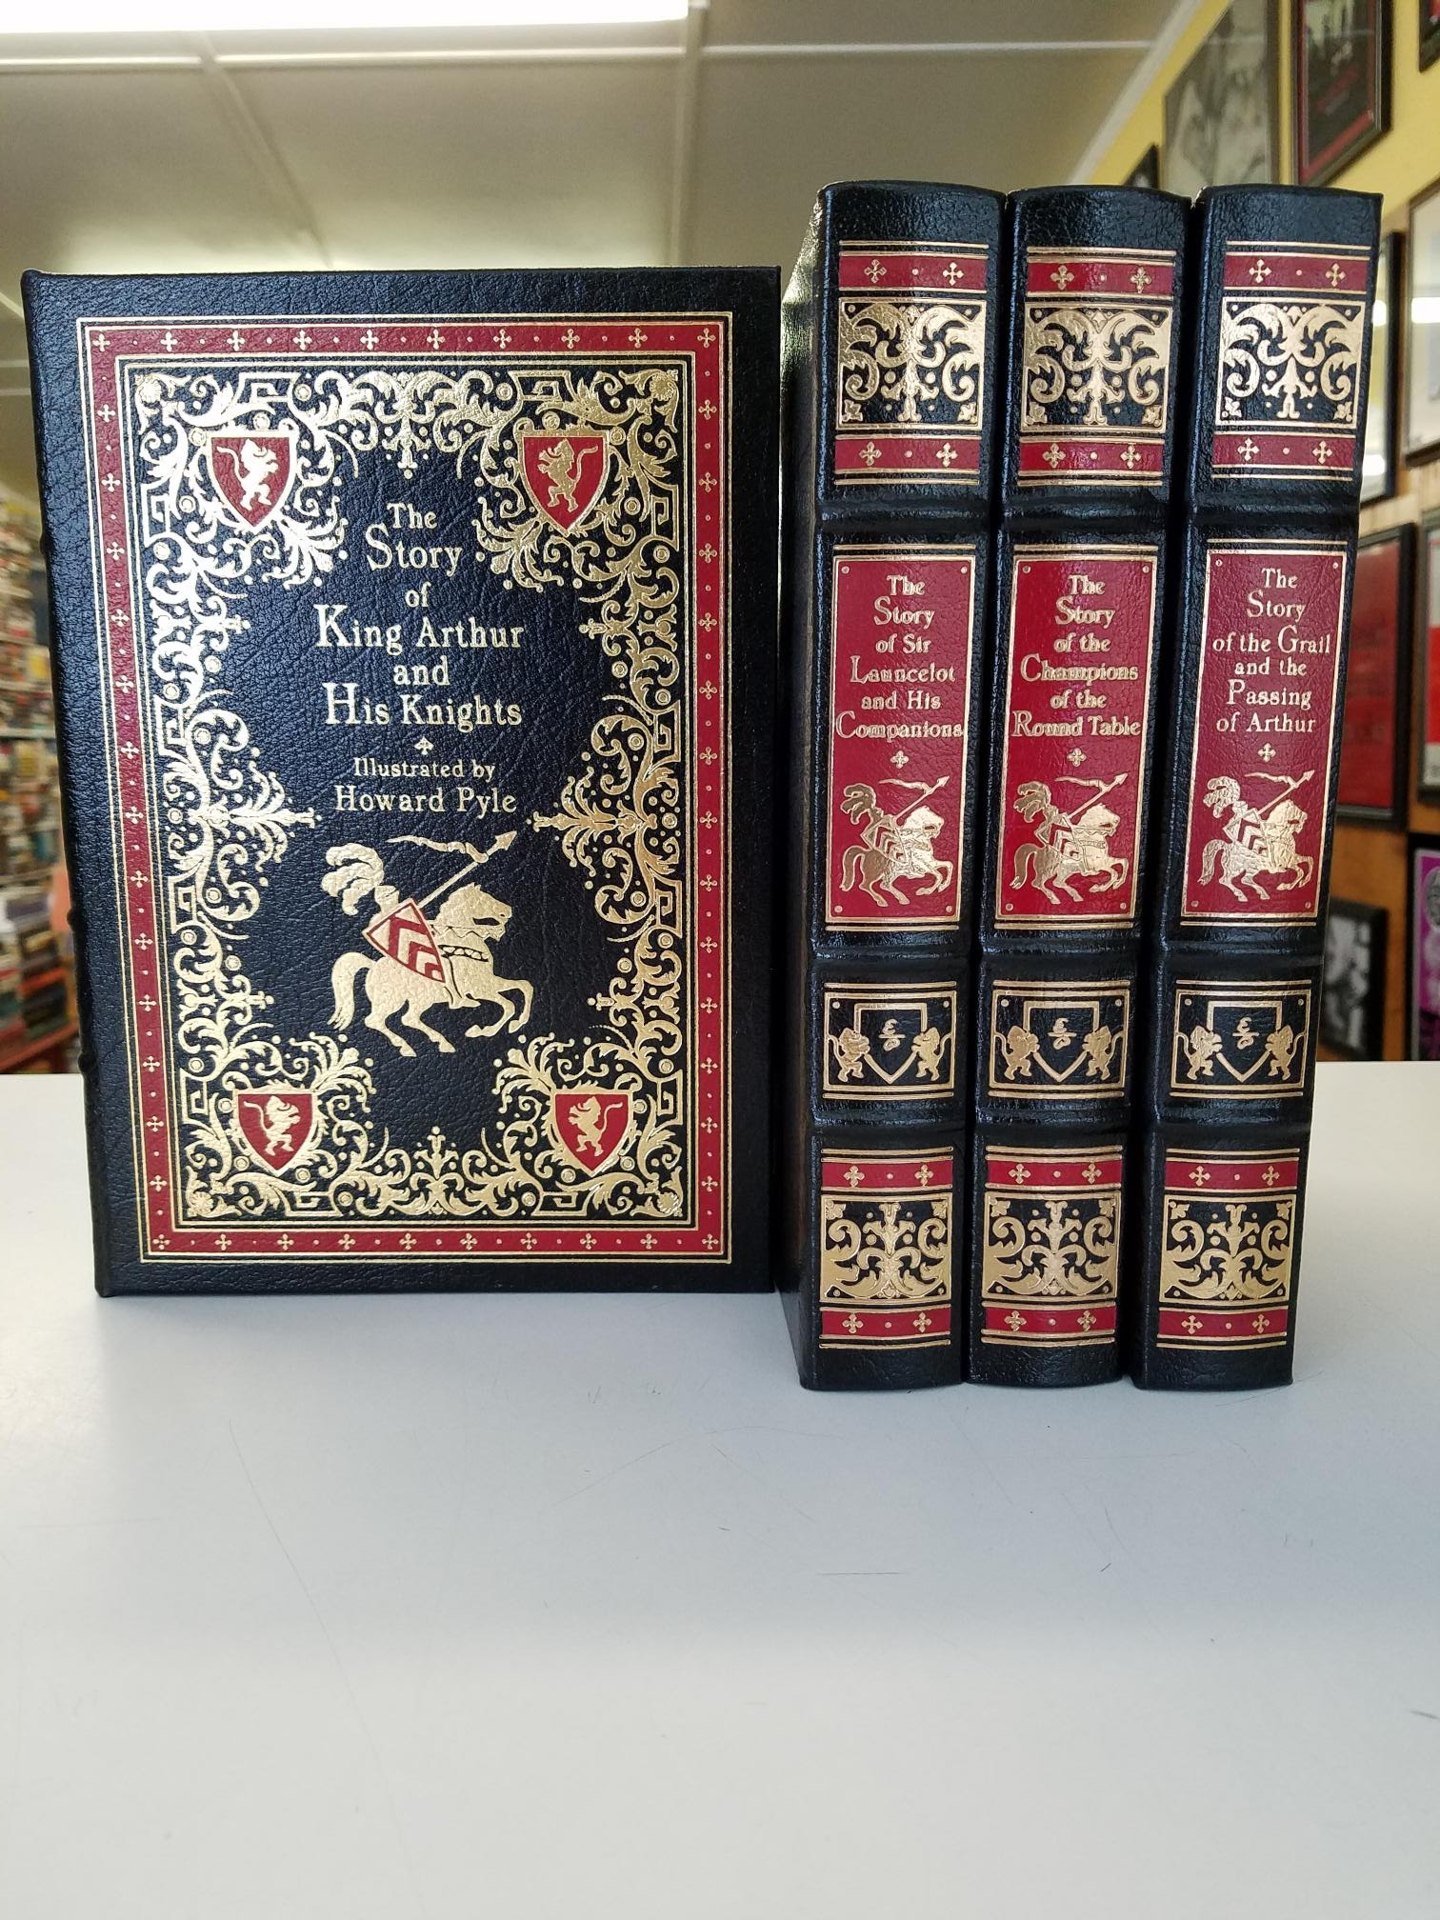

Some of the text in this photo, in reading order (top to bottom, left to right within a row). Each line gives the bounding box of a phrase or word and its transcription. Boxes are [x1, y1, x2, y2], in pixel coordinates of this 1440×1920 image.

[387, 502, 437, 529] The
[366, 523, 462, 576] Story
[887, 575, 925, 595] The
[1068, 575, 1105, 595] The
[1262, 568, 1298, 588] The
[405, 582, 431, 607] of
[1247, 589, 1305, 622] Story
[874, 596, 935, 629] Story
[1055, 596, 1115, 628] Story
[313, 604, 524, 655] King Arthur
[876, 633, 931, 653] of Sir
[1054, 632, 1111, 653] of the
[1212, 625, 1331, 654] of the Grail
[393, 656, 450, 685] and
[850, 655, 955, 684] Launcelot
[1020, 653, 1139, 686] Champions
[1234, 657, 1307, 676] and the
[322, 682, 522, 733] His Knights
[862, 689, 941, 710] and His
[1051, 689, 1107, 709] of the
[1227, 679, 1312, 710] Passing
[835, 711, 964, 741] Companions
[1011, 710, 1141, 737] Round Table
[1216, 713, 1316, 733] of Arthur
[353, 757, 495, 782] Illustrated by
[335, 785, 517, 819] Howard Pyle
